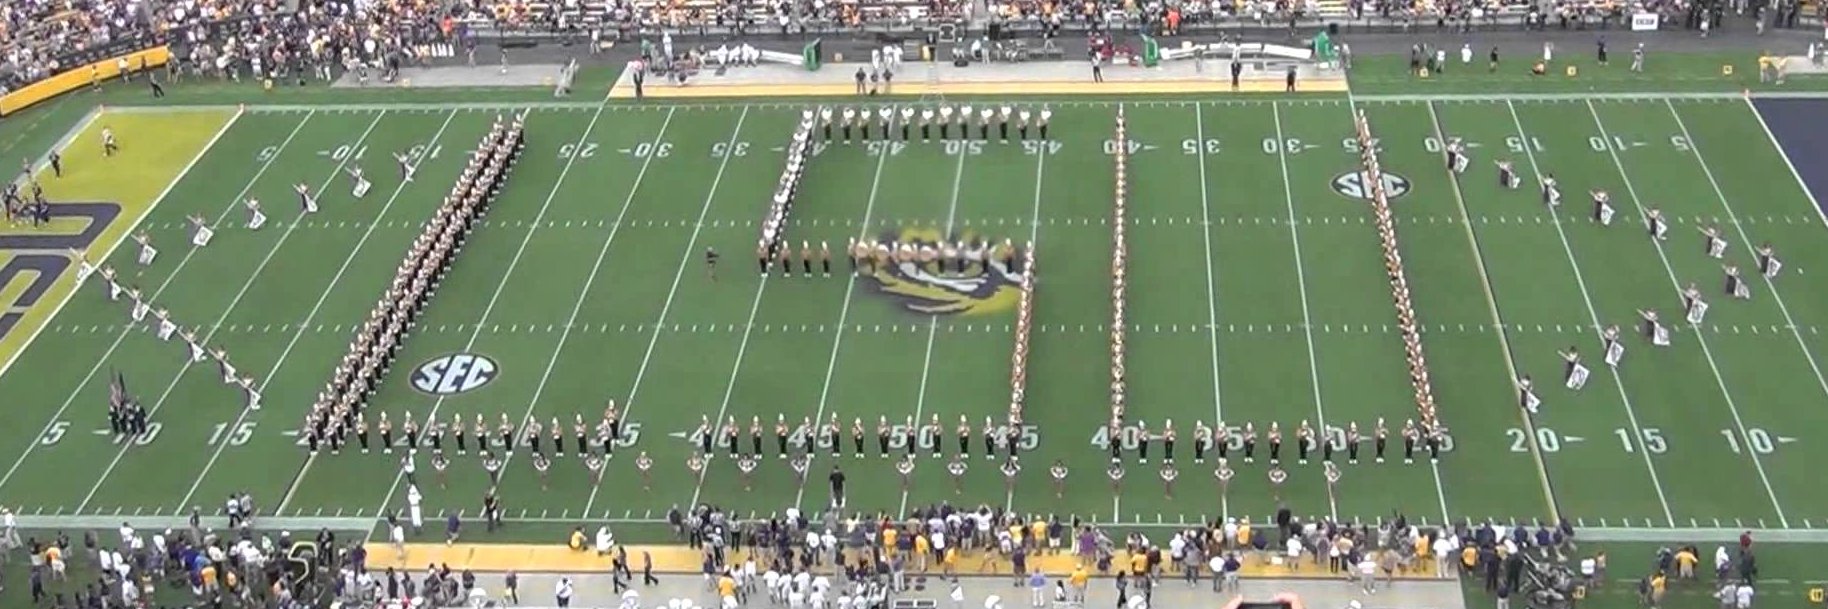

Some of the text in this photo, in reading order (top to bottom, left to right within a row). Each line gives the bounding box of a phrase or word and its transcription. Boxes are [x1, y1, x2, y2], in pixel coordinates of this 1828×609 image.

[332, 144, 369, 160] 10
[558, 141, 599, 159] 25
[634, 141, 674, 158] 30
[711, 141, 750, 158] 35
[867, 140, 906, 156] 45
[944, 139, 984, 155] 50
[1023, 139, 1063, 155] 45
[1103, 138, 1142, 155] 40
[1182, 138, 1221, 155] 35
[1262, 137, 1301, 154] 30
[1505, 136, 1545, 152] 15
[1588, 135, 1627, 152] 10
[412, 354, 498, 393] SEC
[41, 421, 71, 445] 5
[207, 421, 258, 446] 15
[787, 424, 834, 449] 45
[888, 424, 938, 449] 50
[1090, 425, 1140, 451] 40
[1505, 427, 1560, 453] 20
[1615, 427, 1669, 453] 15
[1720, 428, 1776, 454] 10
